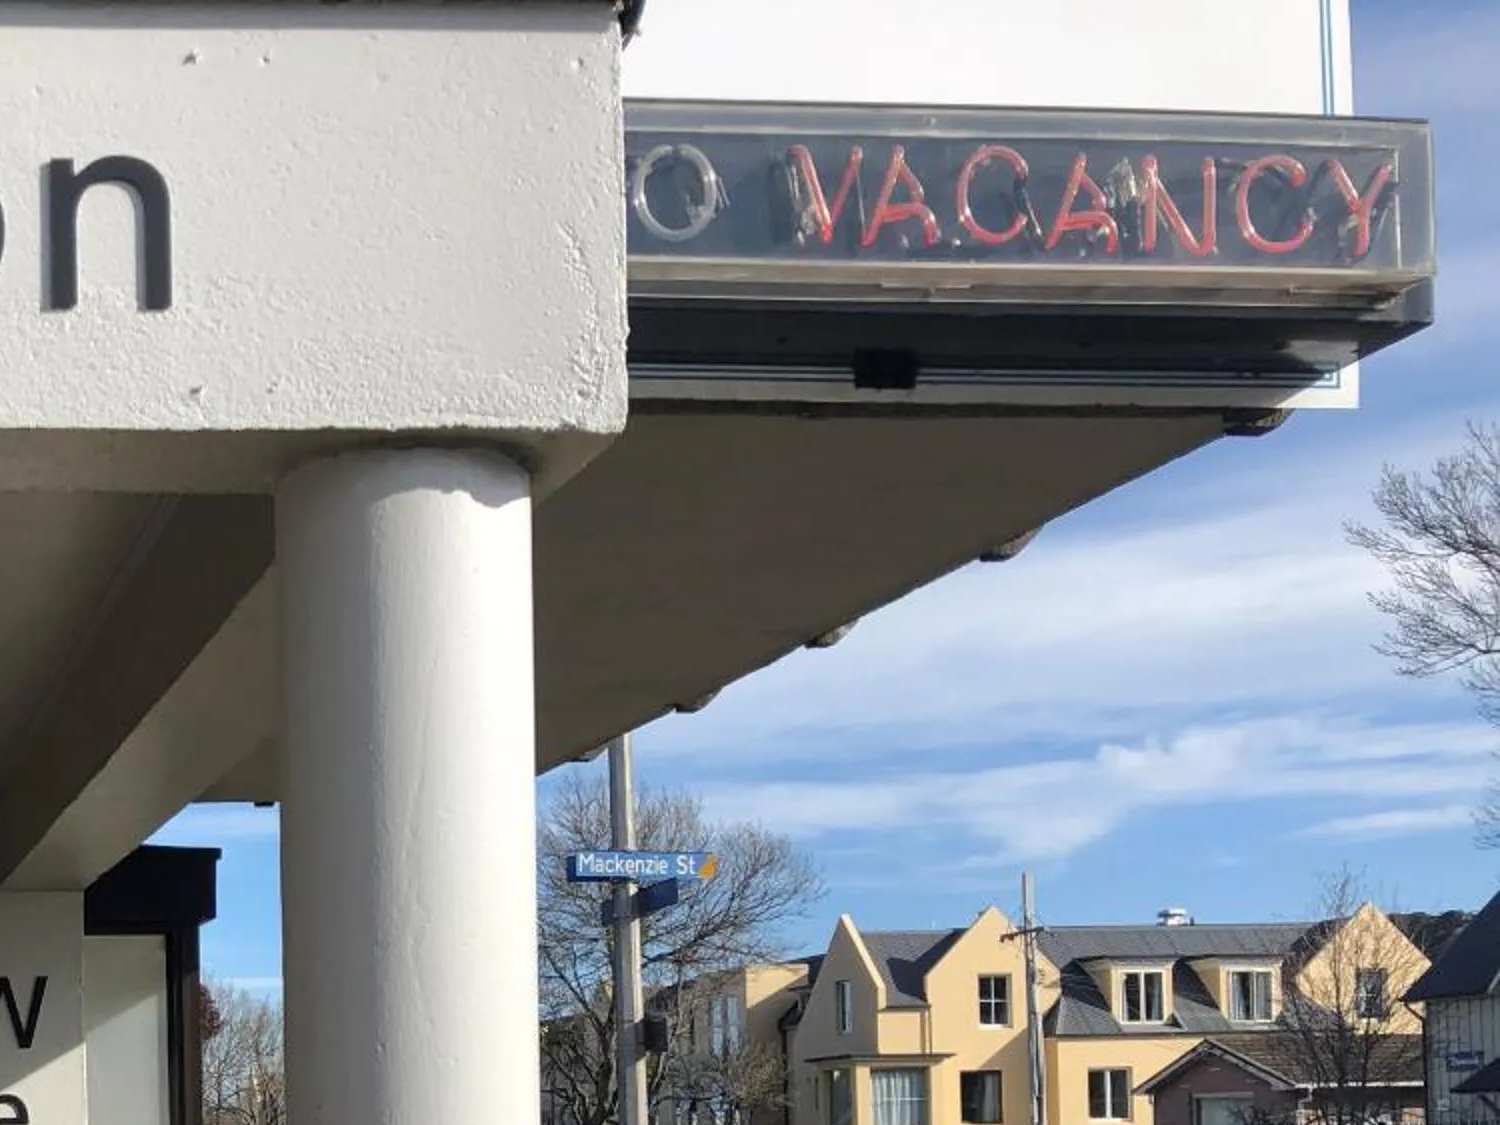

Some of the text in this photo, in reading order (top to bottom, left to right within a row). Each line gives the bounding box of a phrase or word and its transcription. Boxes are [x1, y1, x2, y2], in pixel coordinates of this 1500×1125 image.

[631, 143, 1394, 260] O VACANCY
[578, 852, 697, 876] Mackenzie St
